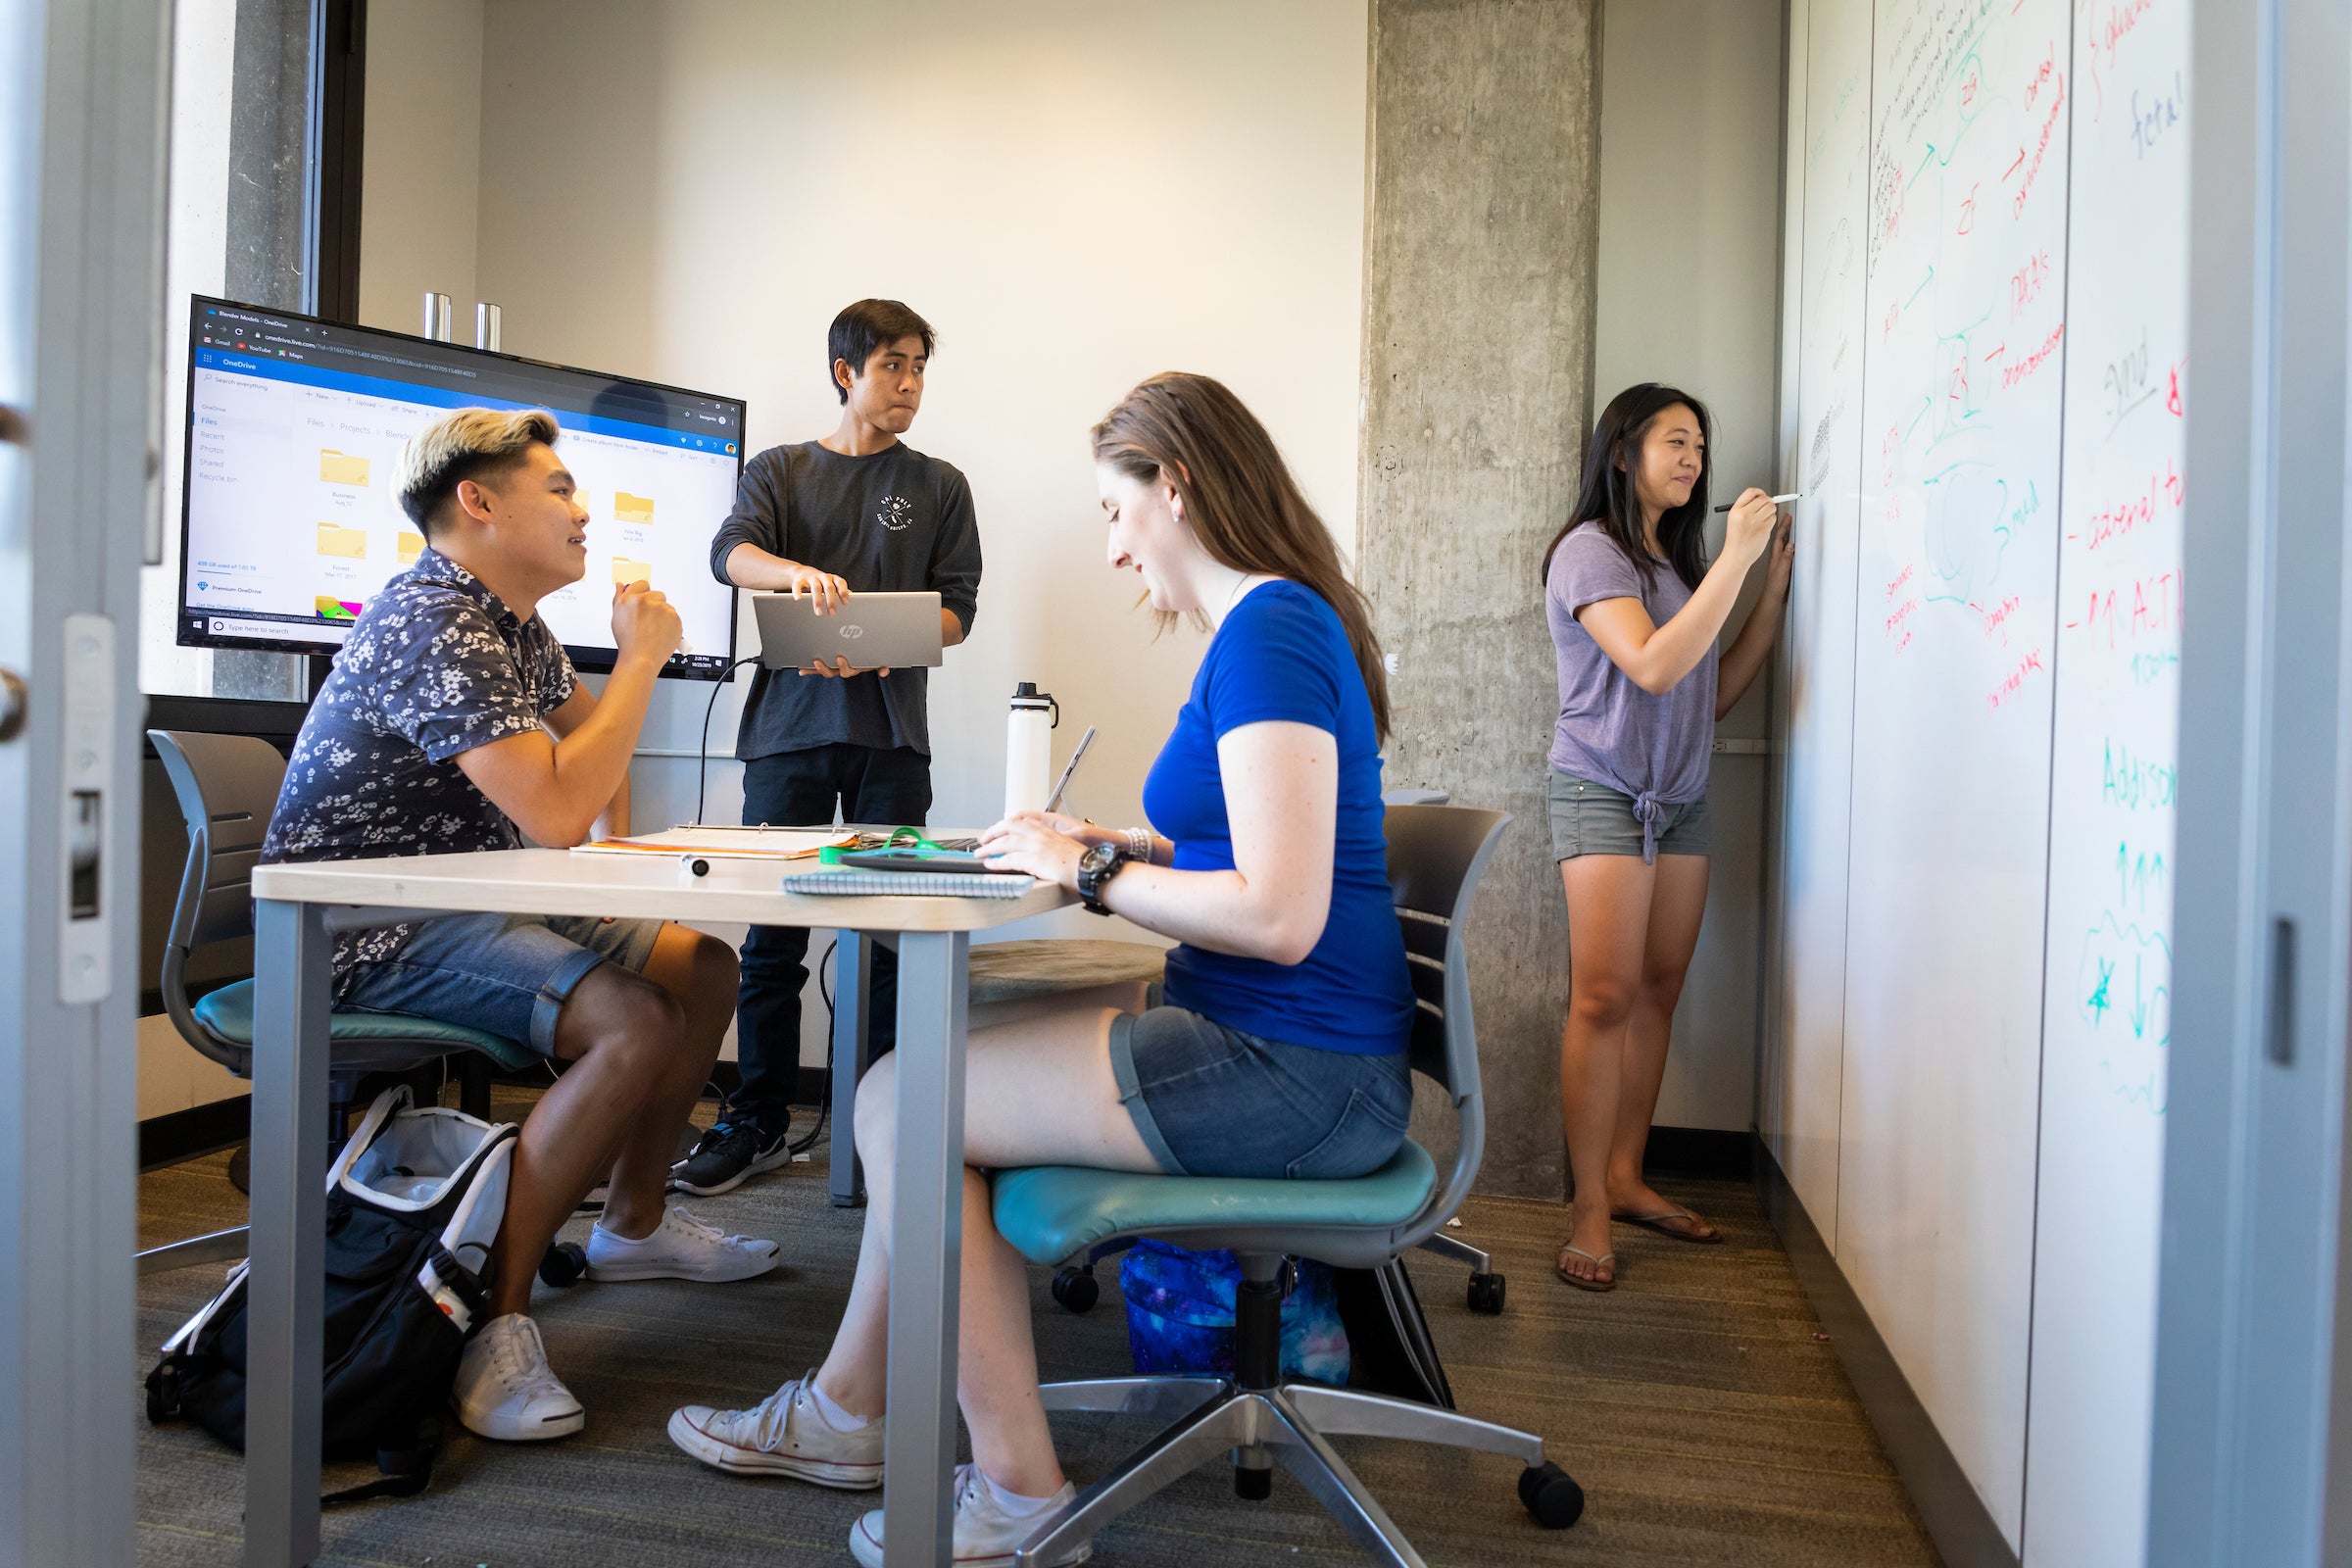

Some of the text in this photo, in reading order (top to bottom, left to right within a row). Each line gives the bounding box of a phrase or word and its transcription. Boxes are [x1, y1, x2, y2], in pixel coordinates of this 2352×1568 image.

[219, 310, 239, 319] Blender
[240, 314, 260, 323] Models
[264, 318, 288, 328] OneDrive
[215, 338, 231, 347] Gmail
[249, 344, 272, 354] YouTube
[288, 351, 304, 360] Maps
[222, 358, 257, 370] OneDrive
[215, 376, 269, 392] Search everything
[356, 399, 376, 408] Upload
[201, 416, 219, 426] Files
[307, 417, 325, 428] Files
[340, 422, 371, 435] Projects
[200, 430, 225, 441] Recent
[200, 444, 224, 455] Photos
[199, 458, 224, 468] Shared
[199, 471, 239, 483] Recycle bin
[228, 623, 243, 632] Type
